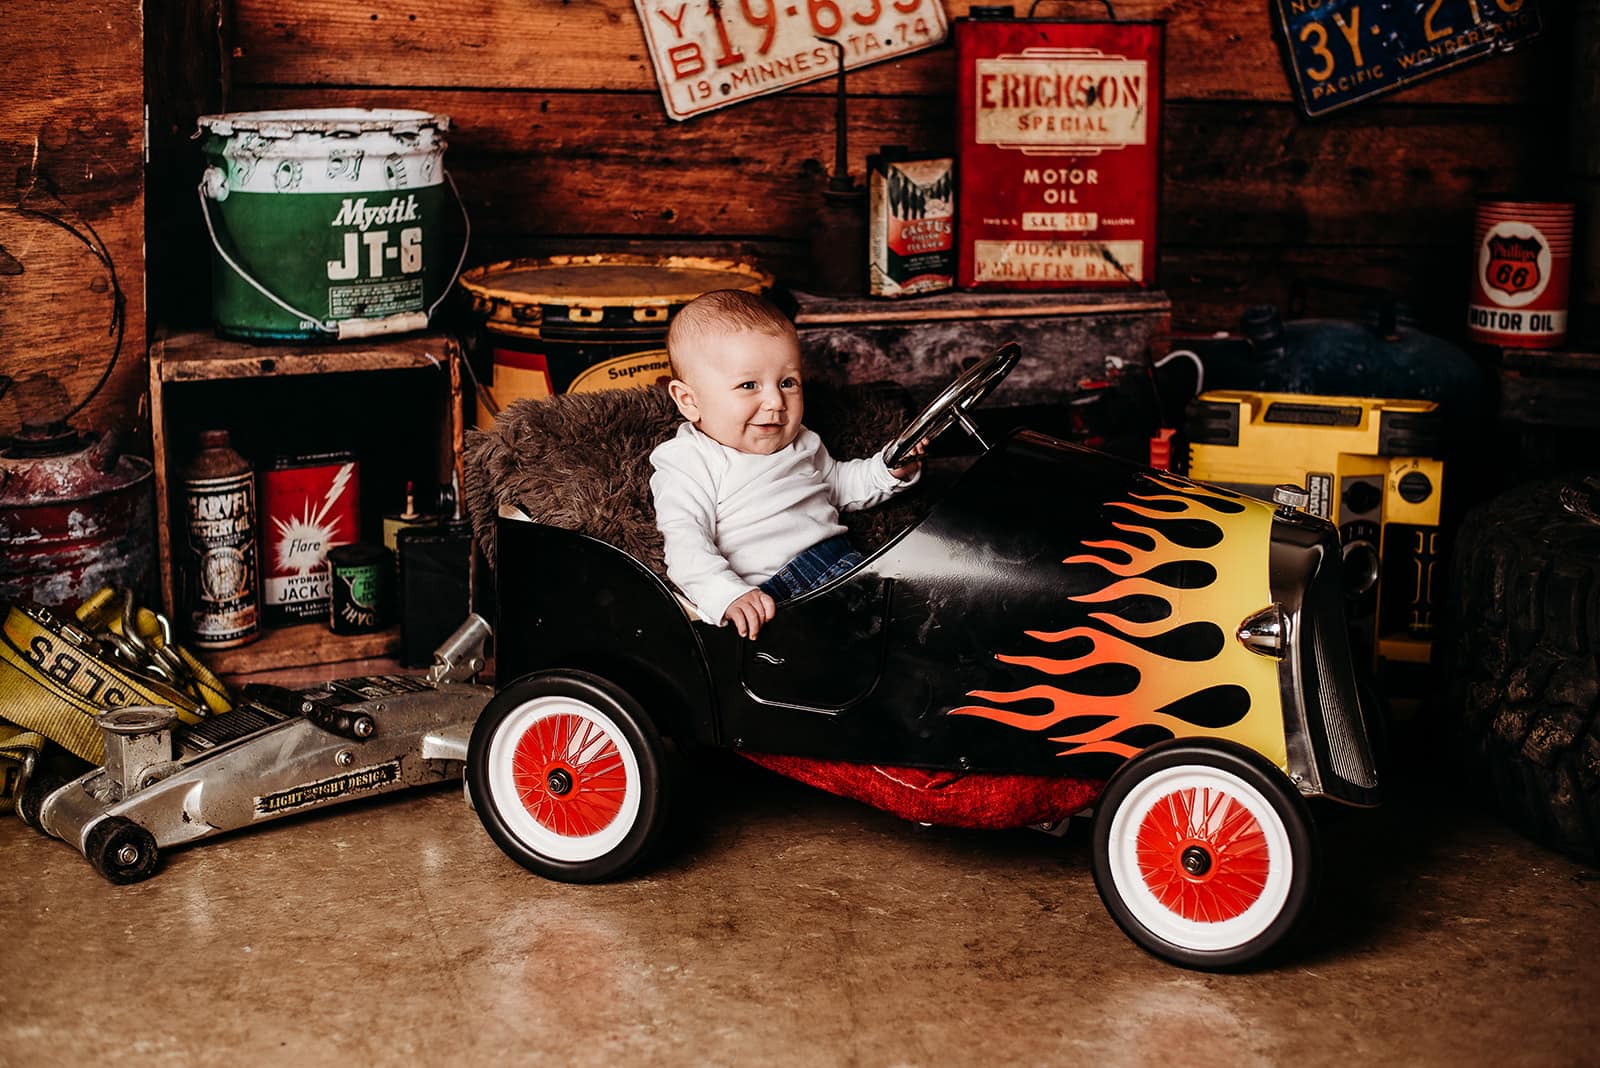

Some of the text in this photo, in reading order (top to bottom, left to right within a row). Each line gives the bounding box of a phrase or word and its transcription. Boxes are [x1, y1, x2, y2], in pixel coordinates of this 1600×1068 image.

[730, 33, 880, 90] MINNESOTA
[894, 17, 929, 43] 74
[981, 74, 1140, 110] ERICKSON
[1312, 64, 1384, 99] PACIFIC
[1017, 114, 1107, 132] SPECIAL
[1023, 168, 1098, 185] MOTOR
[1043, 189, 1078, 204] OIL
[331, 194, 419, 232] Mystik
[901, 220, 951, 240] CACTUS
[327, 227, 422, 280] JT-6
[1497, 264, 1529, 287] 66
[1470, 307, 1553, 332] MOTOR OIL
[608, 361, 668, 380] Supreme
[288, 538, 321, 557] Flare
[279, 585, 319, 602] JACK
